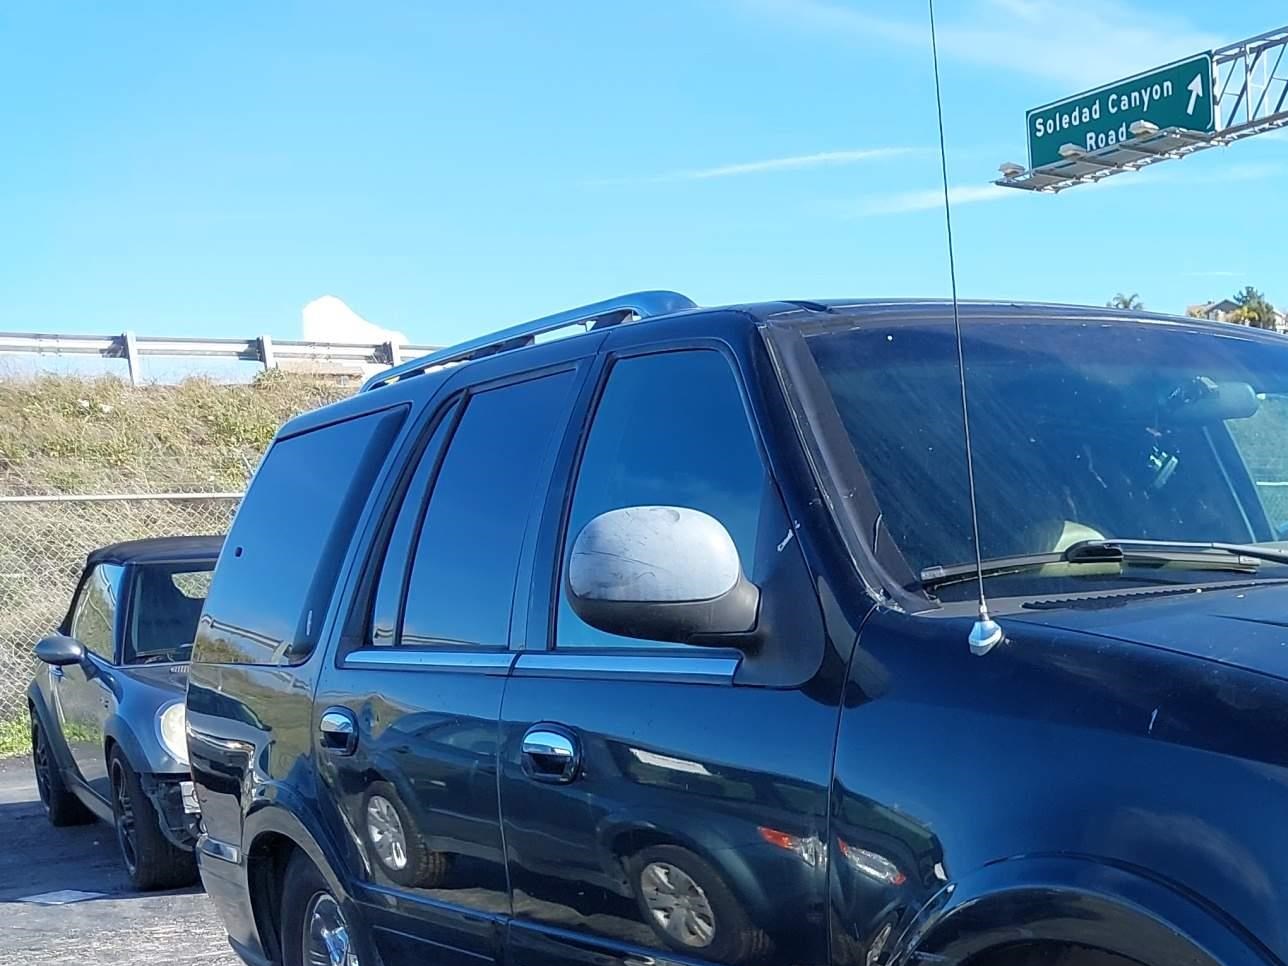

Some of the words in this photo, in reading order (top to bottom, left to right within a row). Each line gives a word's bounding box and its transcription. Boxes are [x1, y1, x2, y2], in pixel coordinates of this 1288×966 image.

[1035, 101, 1100, 137] Soledad
[1108, 80, 1173, 114] Canyon
[1086, 122, 1127, 152] Road
